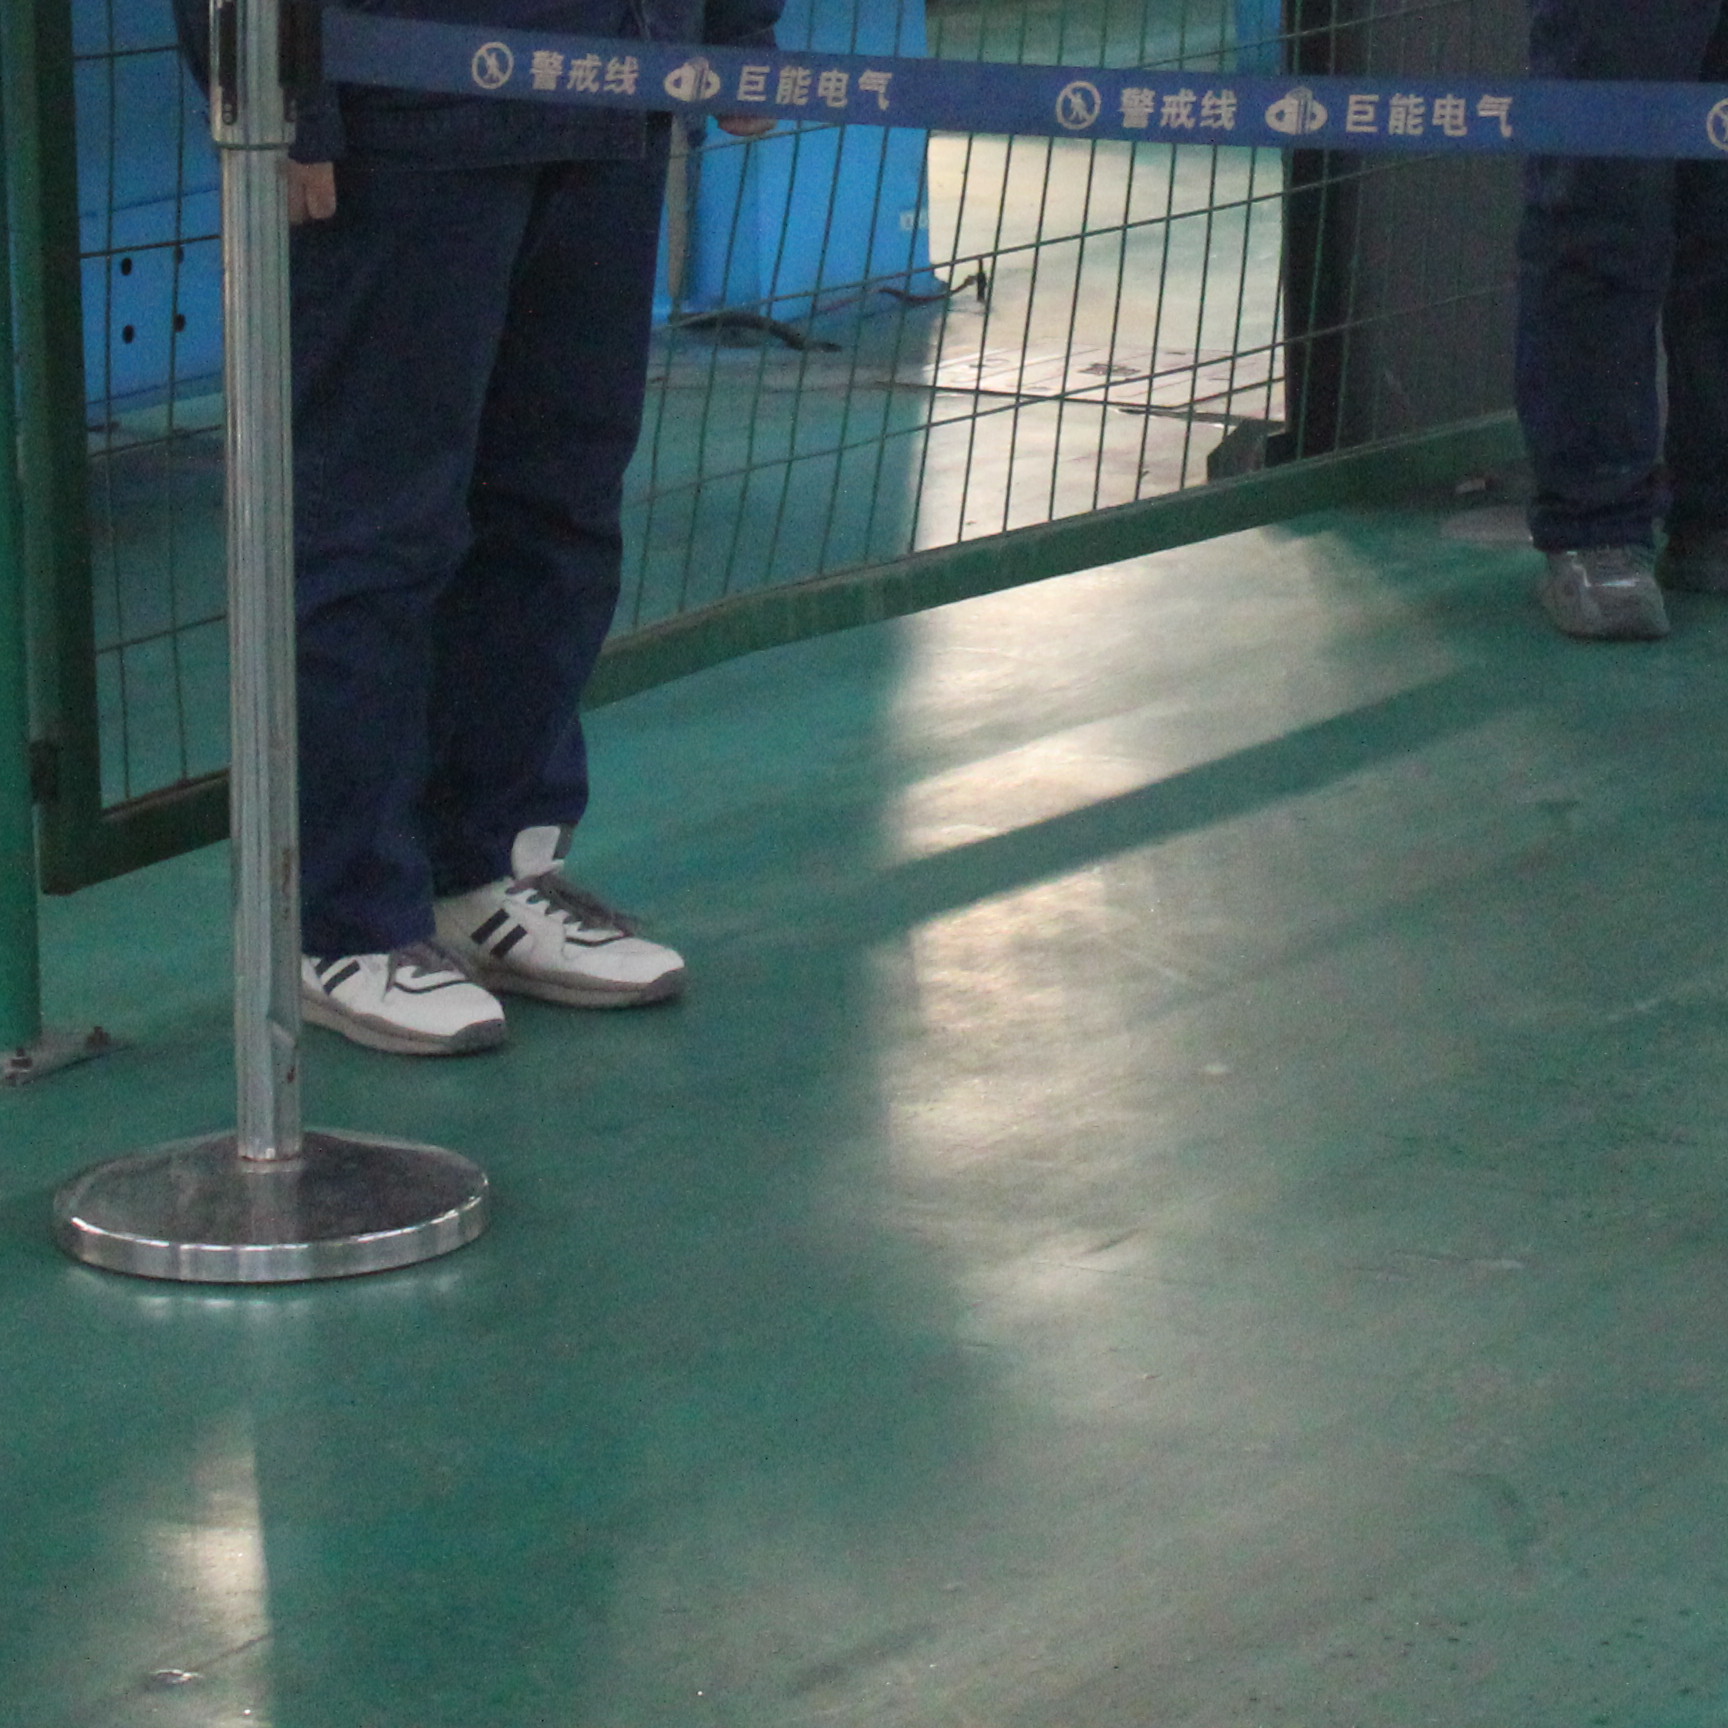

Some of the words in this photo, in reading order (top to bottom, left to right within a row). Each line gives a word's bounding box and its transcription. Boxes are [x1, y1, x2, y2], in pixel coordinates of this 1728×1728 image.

[529, 49, 640, 95] 警戒线
[736, 64, 893, 111] 巨能电气
[1118, 86, 1238, 131] 警戒线
[1345, 92, 1514, 139] 巨能电气
